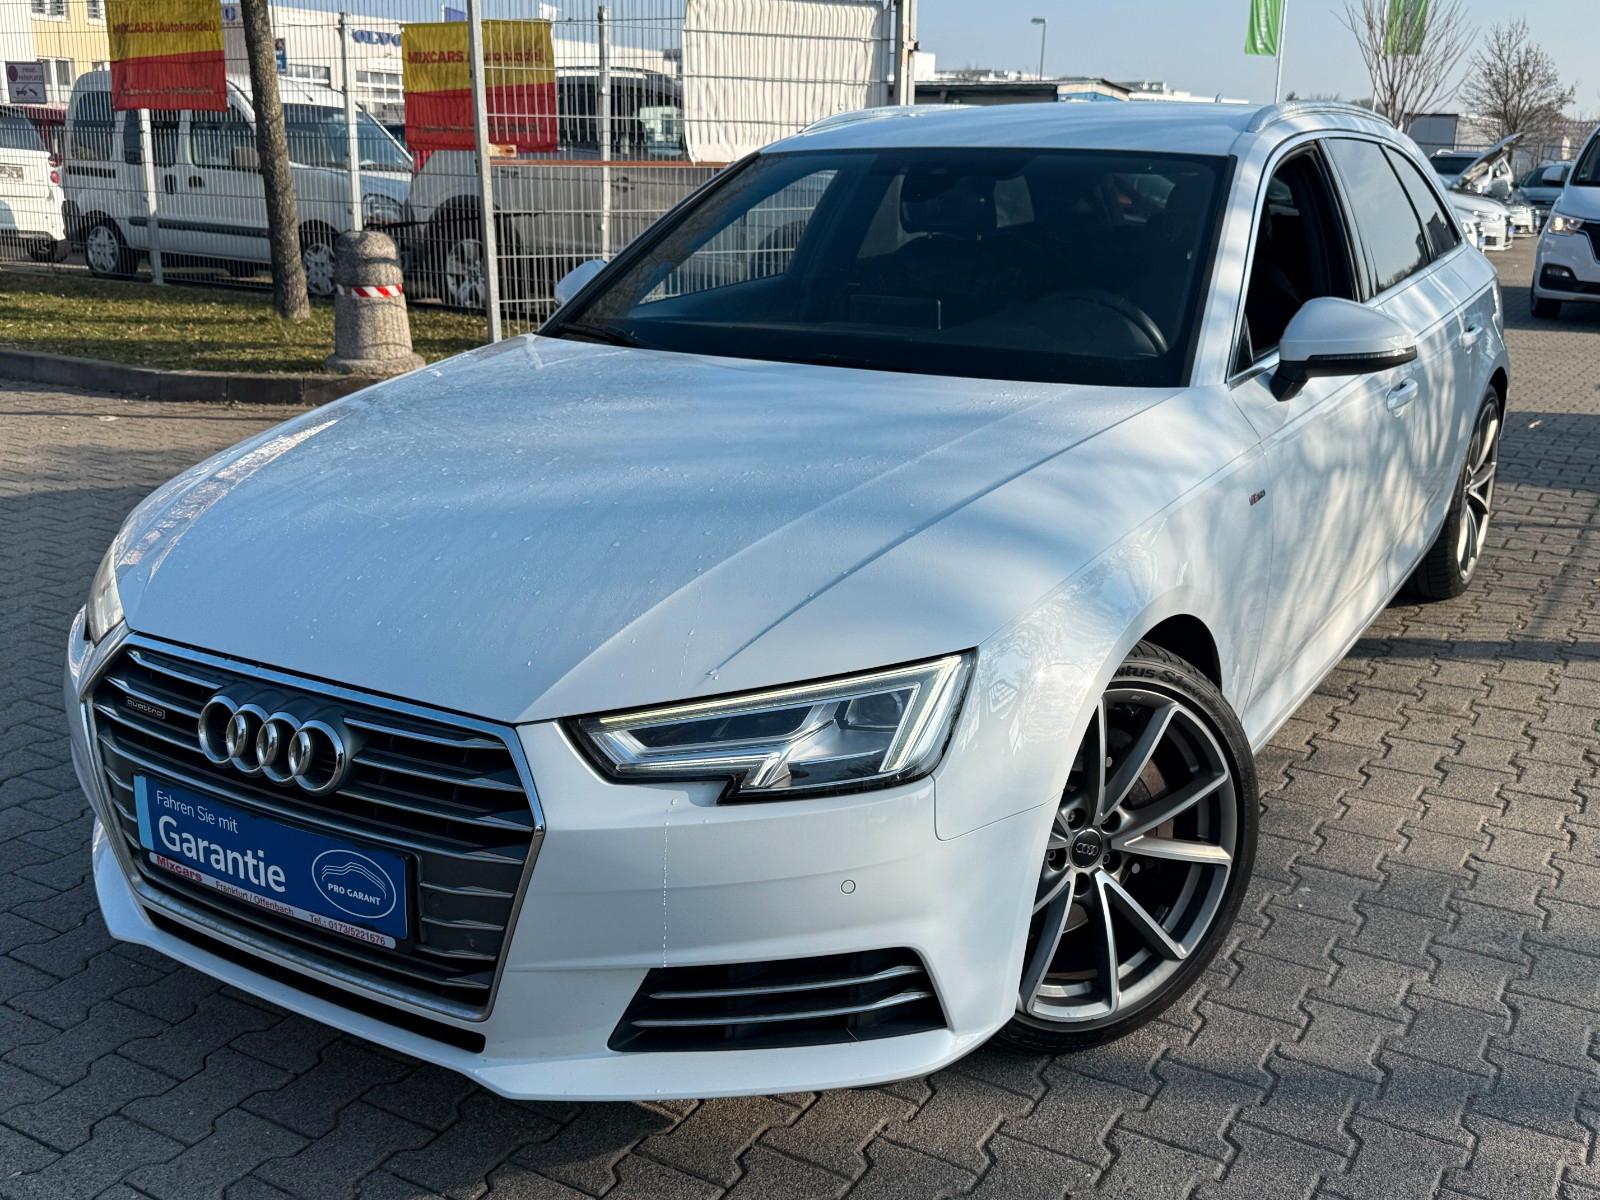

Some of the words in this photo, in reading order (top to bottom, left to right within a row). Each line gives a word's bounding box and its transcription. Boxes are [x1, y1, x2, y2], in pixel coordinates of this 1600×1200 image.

[113, 22, 154, 34] MIXCARS
[352, 29, 401, 47] OLVO
[408, 50, 464, 64] MIXCARS
[127, 699, 163, 717] quattro
[156, 790, 194, 817] Fahren
[197, 805, 216, 825] Sie
[219, 816, 239, 834] mit
[158, 815, 286, 893] Garantie
[156, 855, 203, 882] Mixcars
[215, 880, 248, 899] Frankfurt
[254, 895, 294, 917] Offenbach
[327, 882, 345, 895] PRO
[346, 888, 381, 906] GARANT
